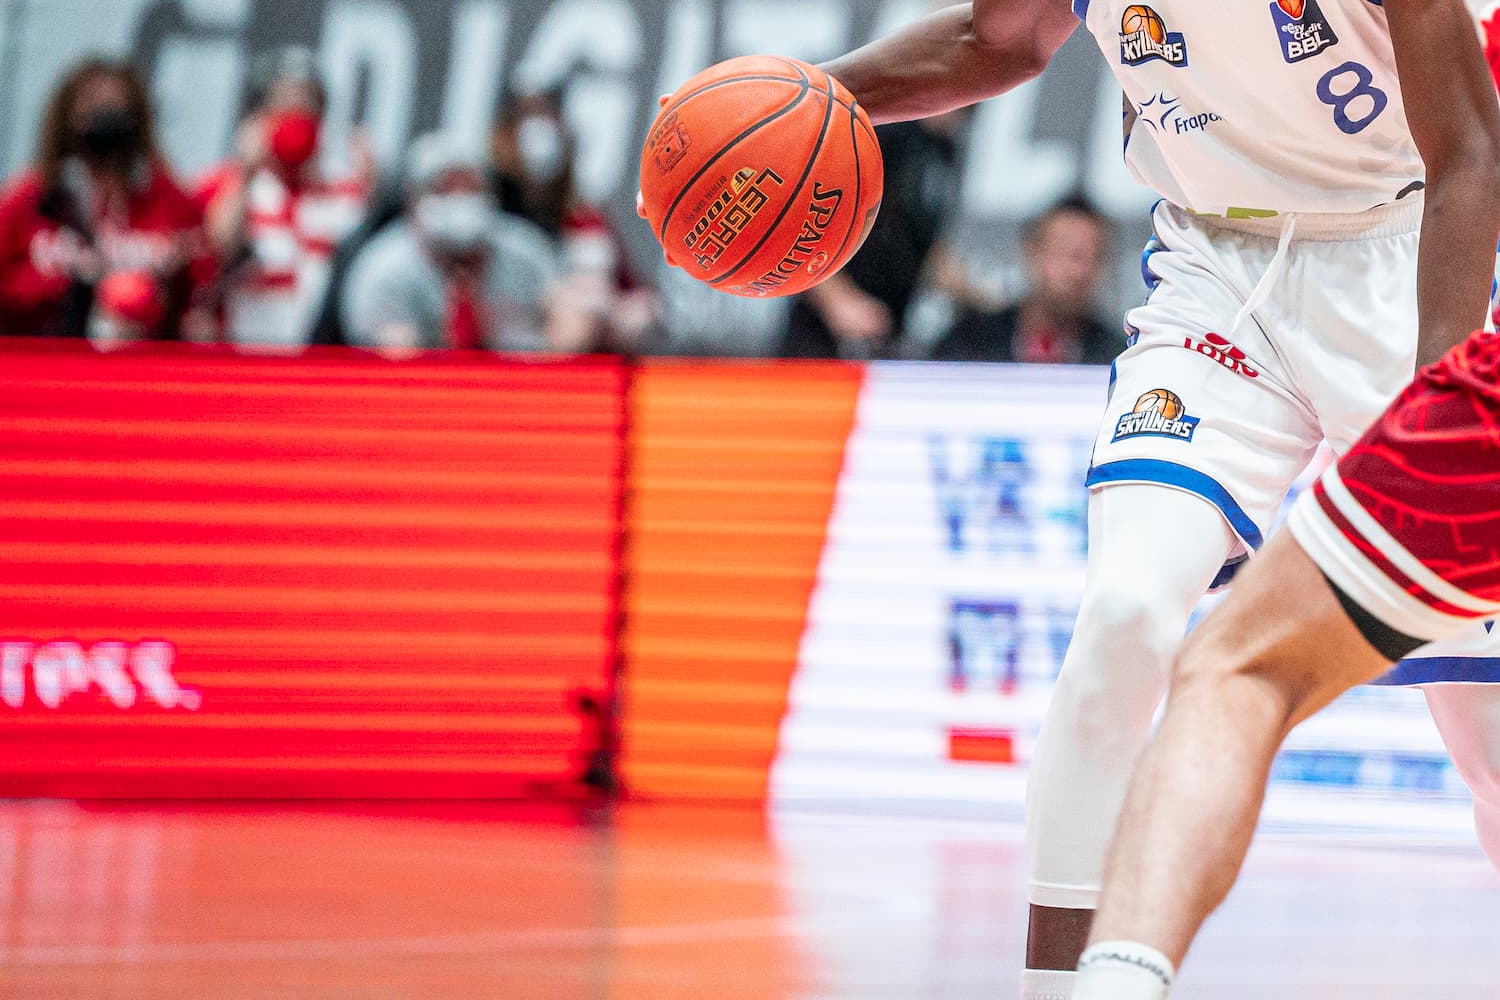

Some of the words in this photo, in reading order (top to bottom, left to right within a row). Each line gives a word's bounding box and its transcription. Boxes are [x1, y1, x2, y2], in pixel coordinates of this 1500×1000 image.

[1287, 31, 1330, 59] BBL
[1316, 61, 1388, 135] 8
[684, 189, 735, 249] 1000
[692, 167, 785, 271] LEGACY
[1115, 406, 1193, 438] SKYLINERS
